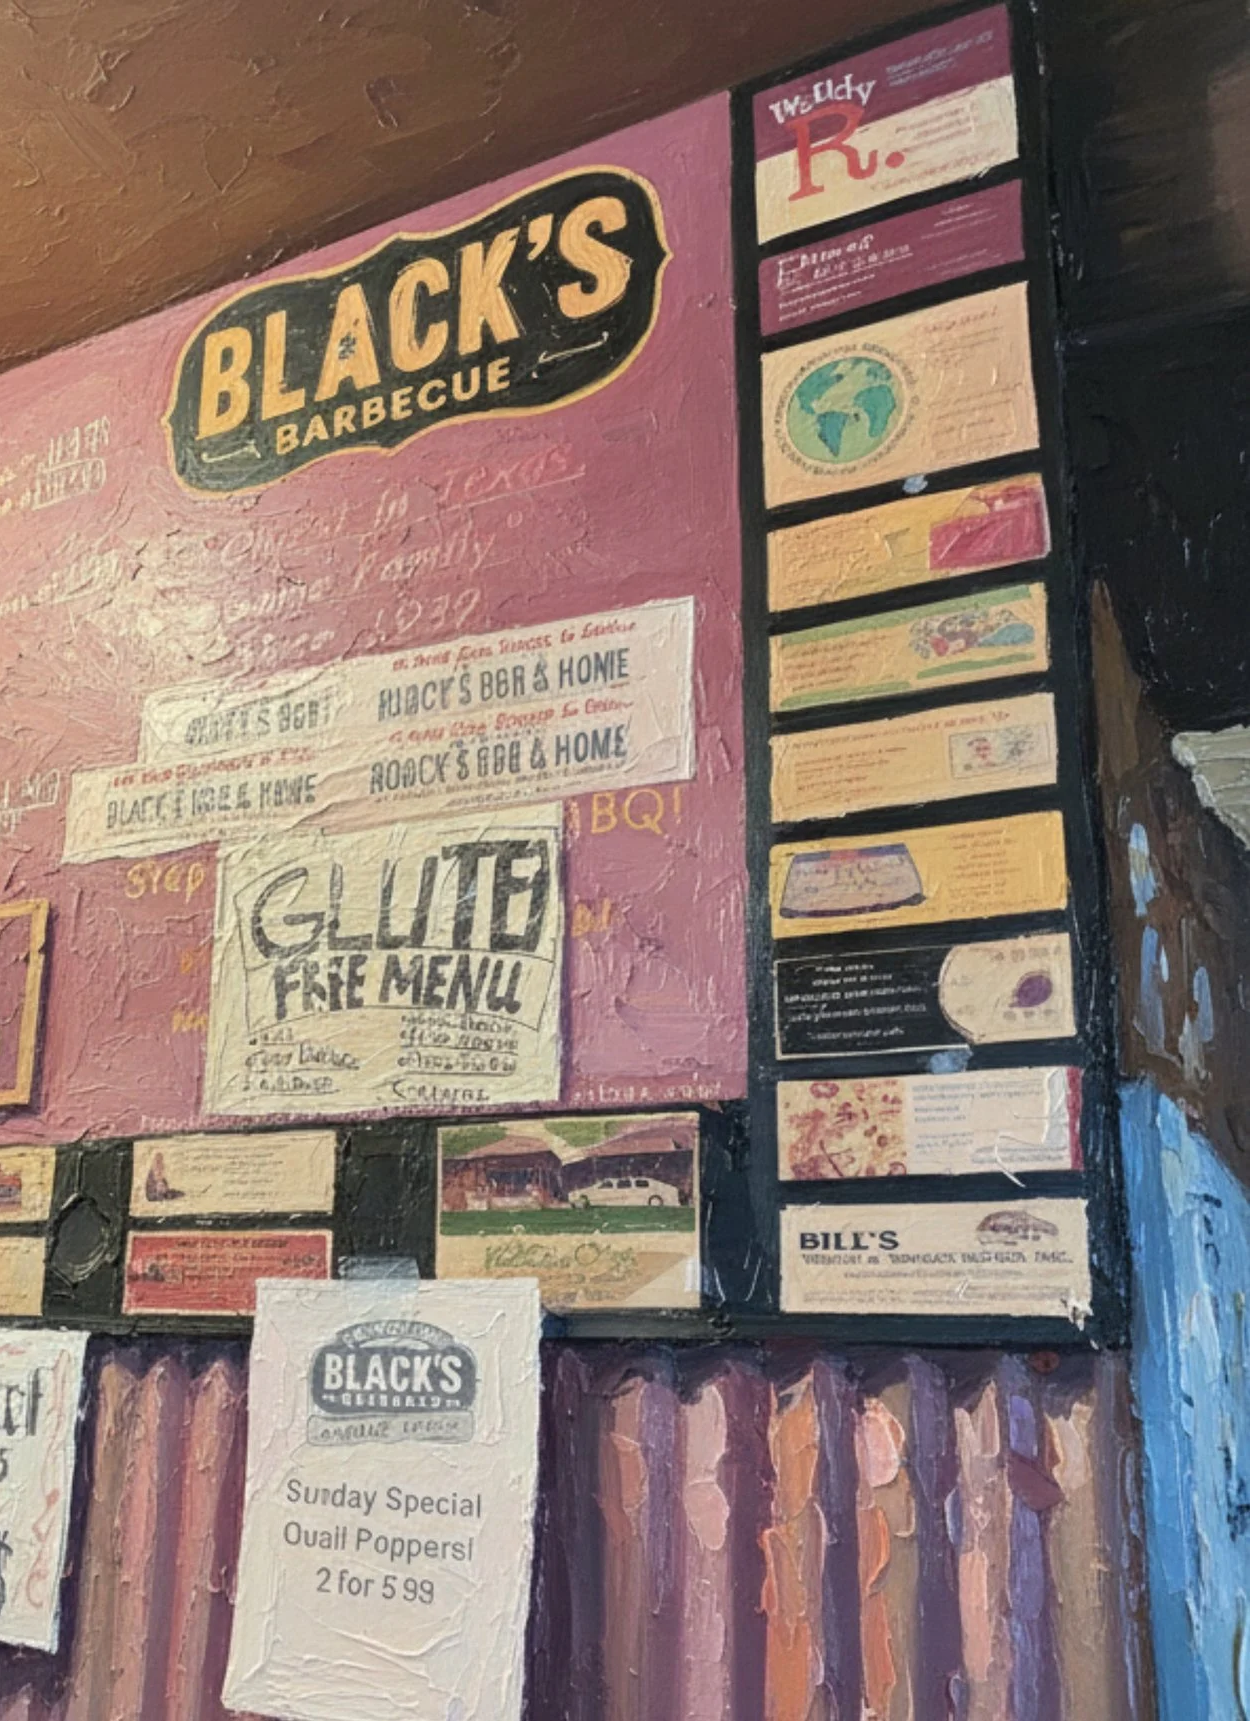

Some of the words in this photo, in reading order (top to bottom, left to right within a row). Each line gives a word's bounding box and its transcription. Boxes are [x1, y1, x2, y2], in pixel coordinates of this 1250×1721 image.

[197, 196, 632, 441] BLACK'S
[275, 356, 511, 455] BARBECUE
[274, 954, 369, 1020] FREE
[379, 953, 522, 1014] MENU
[800, 1230, 899, 1251] BILL'S
[323, 1352, 463, 1394] BLACK'S
[385, 1486, 483, 1519] Special
[315, 1566, 332, 1593] 2
[337, 1569, 375, 1598] for
